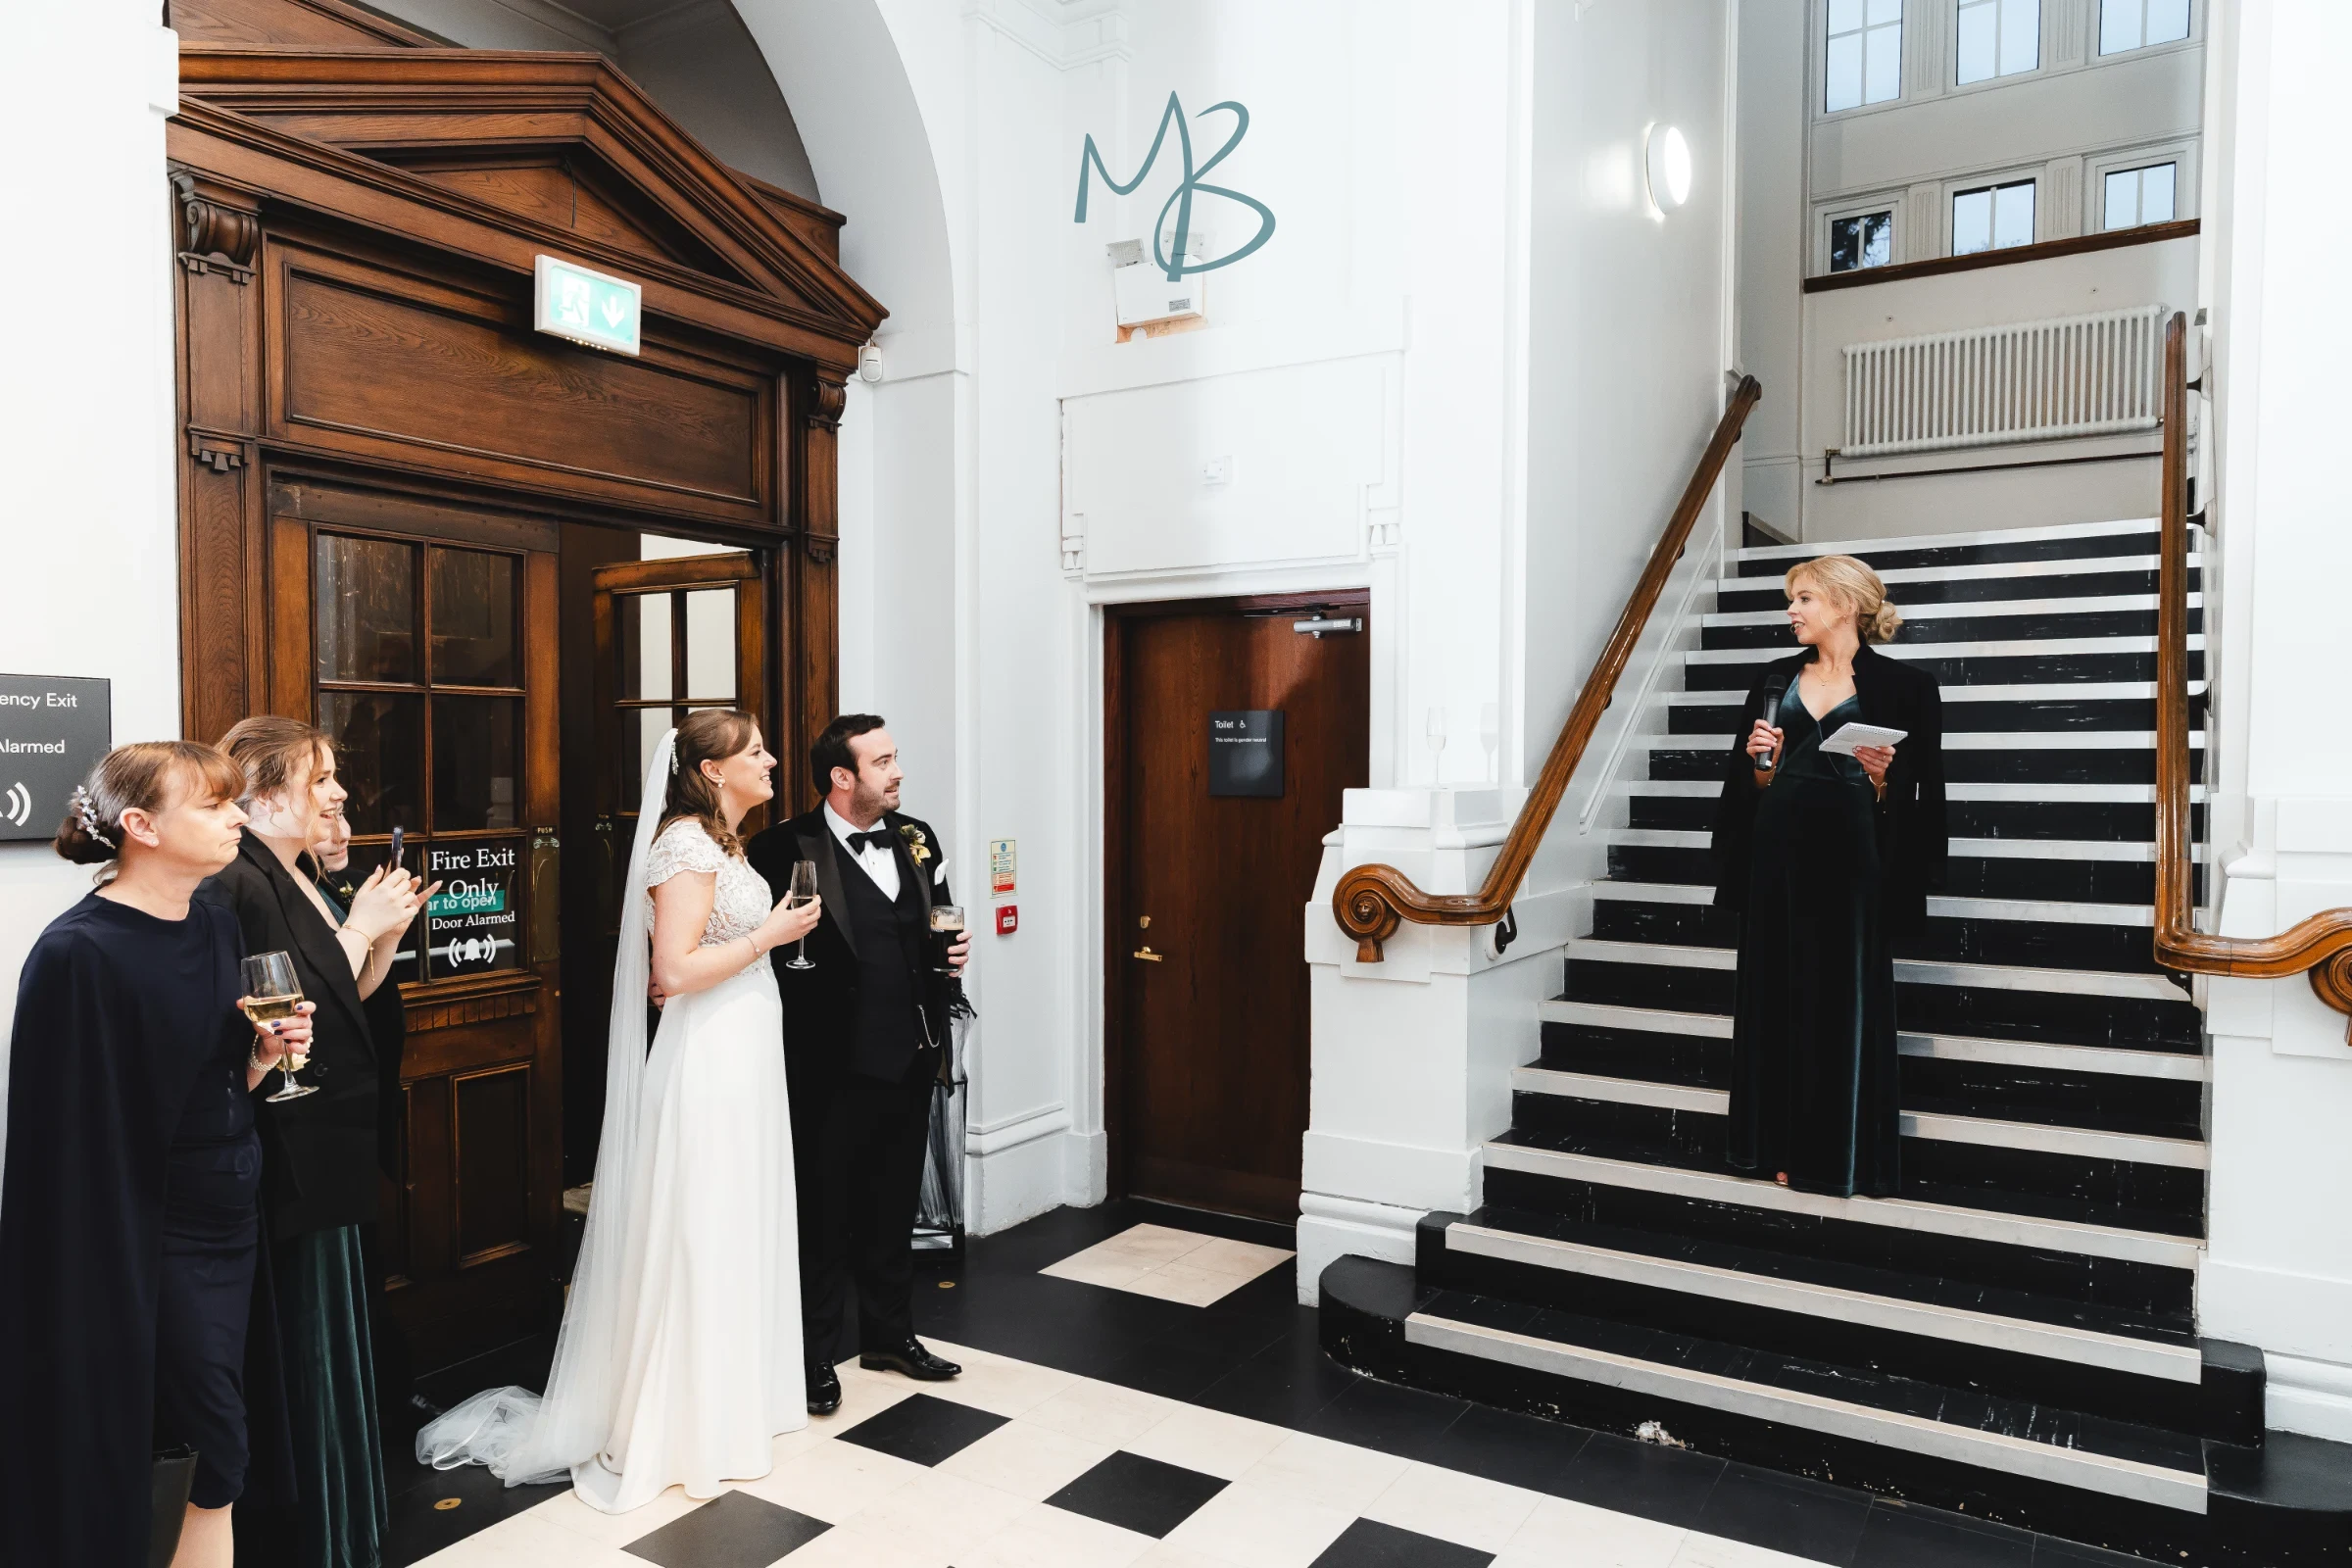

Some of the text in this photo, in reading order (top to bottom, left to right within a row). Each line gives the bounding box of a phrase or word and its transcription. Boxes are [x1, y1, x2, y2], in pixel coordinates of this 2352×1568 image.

[0, 693, 77, 710] ency Exit
[1215, 720, 1234, 729] Toilet
[431, 848, 515, 871] Fire Exit
[449, 878, 499, 903] Only
[443, 898, 458, 909] to
[462, 896, 497, 910] open
[432, 910, 515, 930] Door Alarmed
